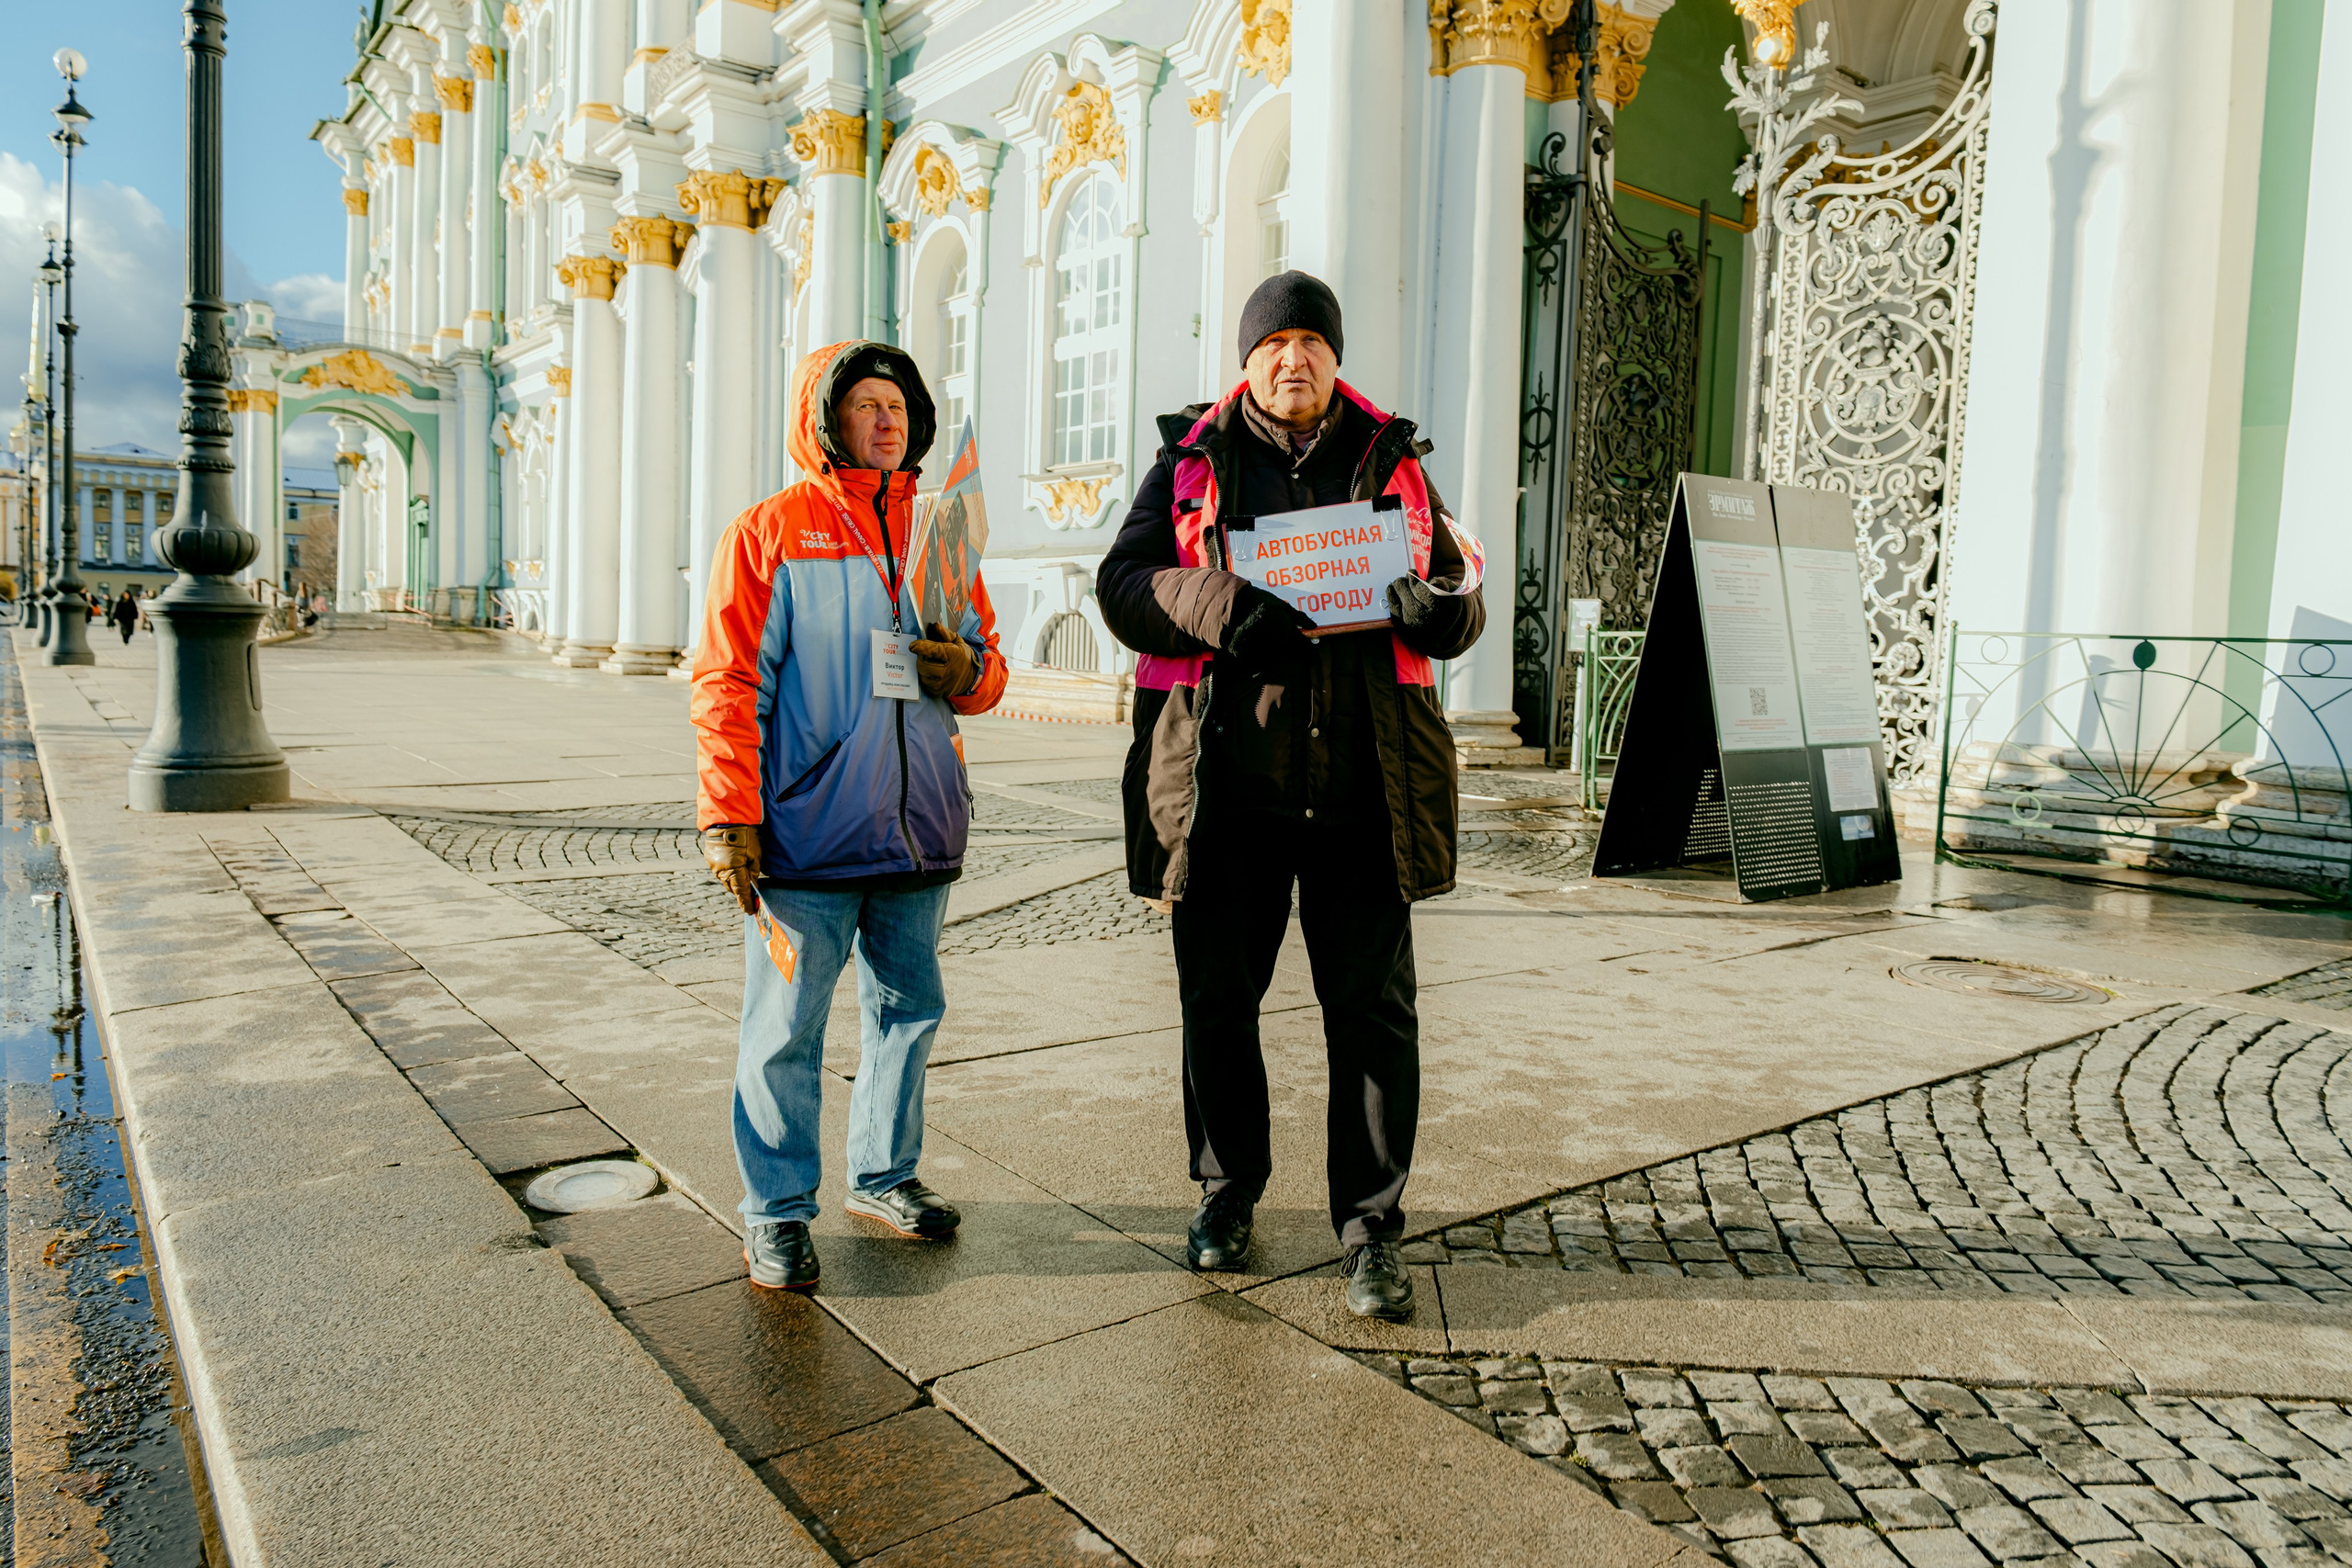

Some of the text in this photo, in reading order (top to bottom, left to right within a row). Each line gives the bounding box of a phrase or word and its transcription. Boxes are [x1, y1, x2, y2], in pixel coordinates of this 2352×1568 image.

[1707, 493, 1756, 516] ЭРМИТАЖ
[842, 512, 855, 528] CRUISE
[799, 539, 828, 549] TOUR
[809, 531, 830, 541] CITY
[1257, 525, 1382, 559] АВТОБУСНАЯ
[1266, 556, 1370, 588] ОБЗОРНАЯ
[1296, 587, 1374, 613] ГОРОДУ
[885, 661, 905, 671] Виктор
